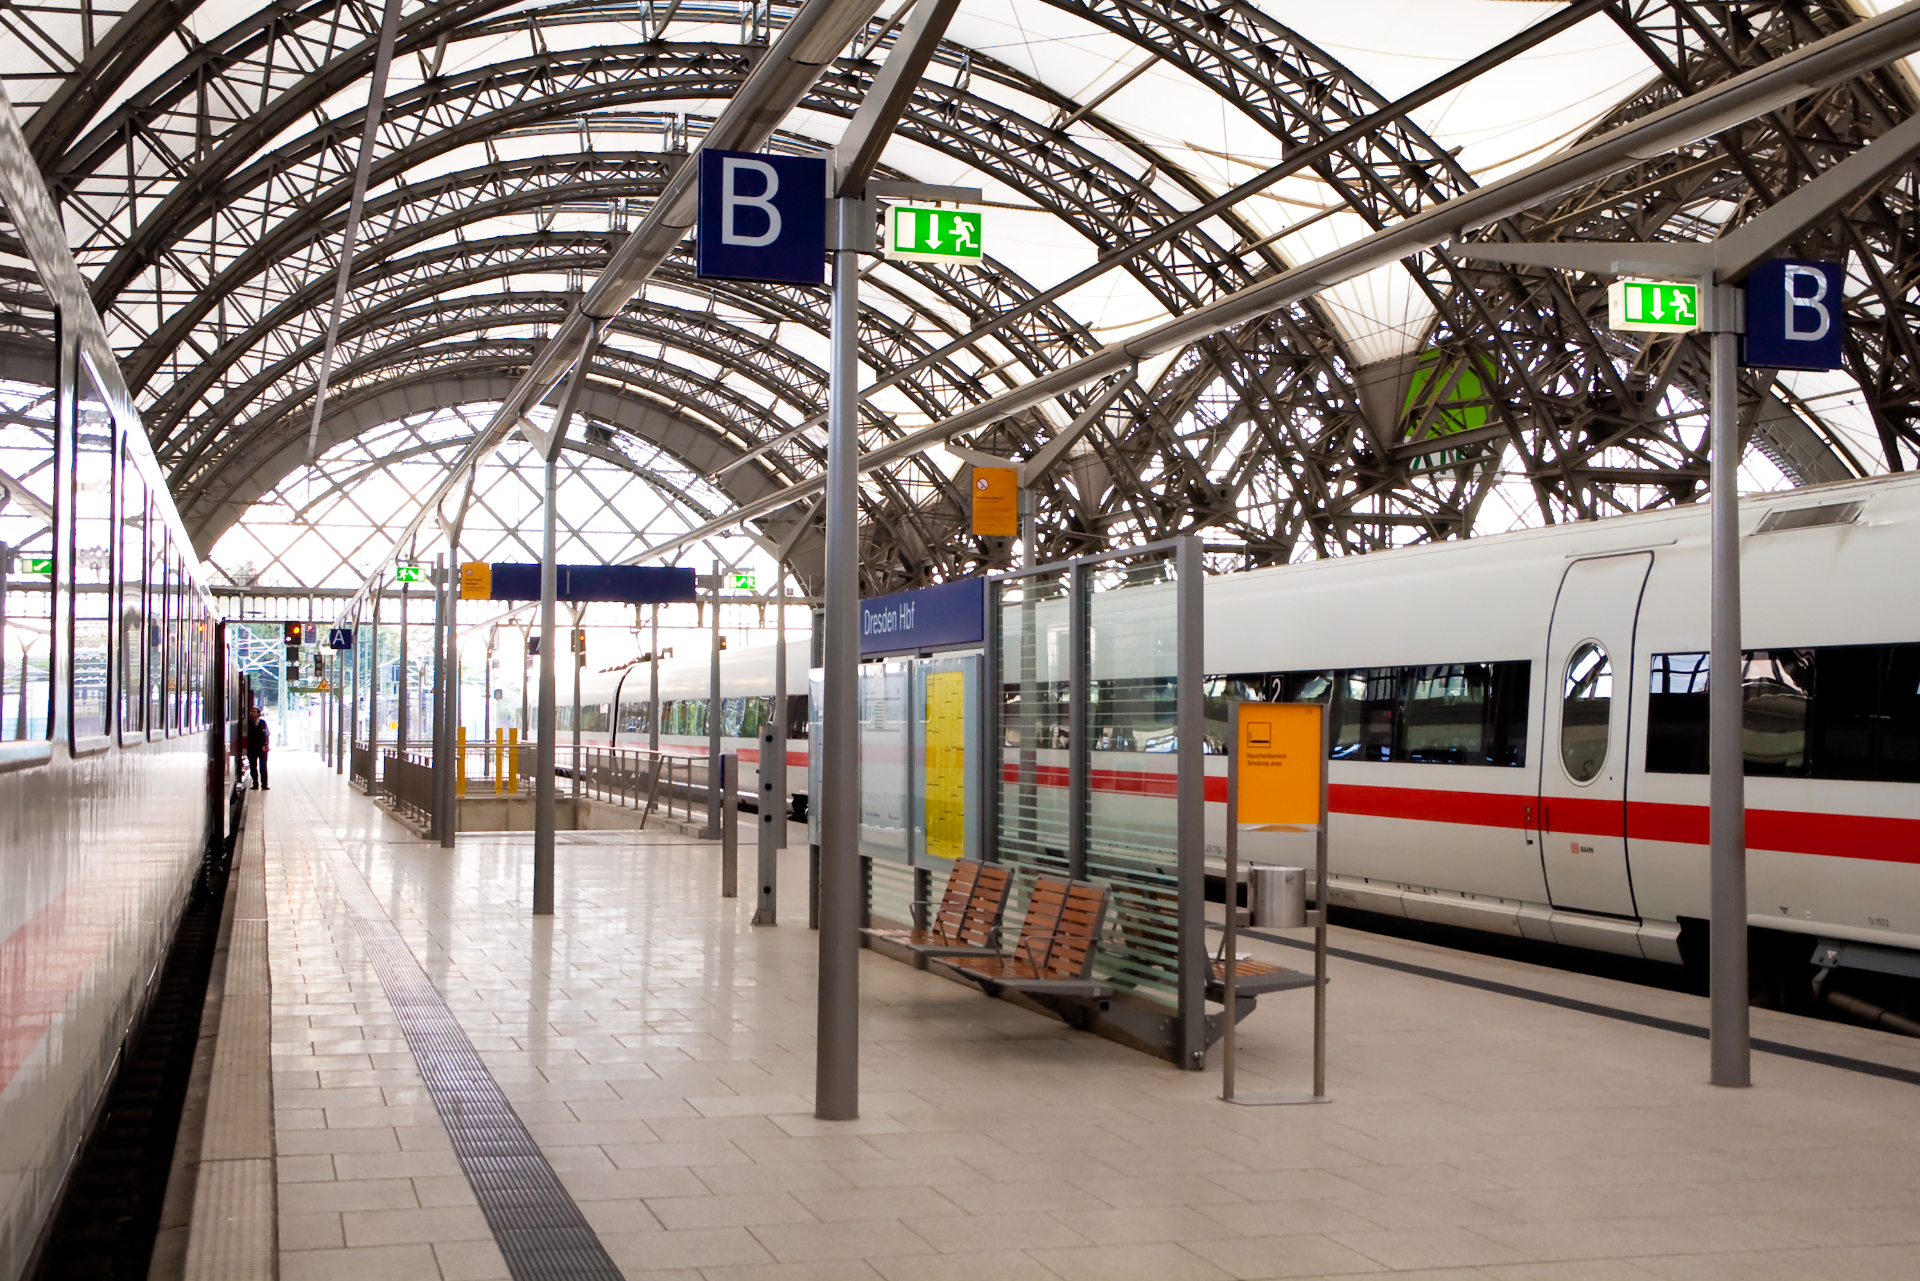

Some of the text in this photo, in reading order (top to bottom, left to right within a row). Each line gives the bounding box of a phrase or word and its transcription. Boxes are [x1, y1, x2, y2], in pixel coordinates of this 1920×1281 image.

[721, 157, 782, 247] B
[1784, 264, 1831, 342] B
[332, 629, 346, 645] A
[864, 600, 916, 636] Dresden Hbf
